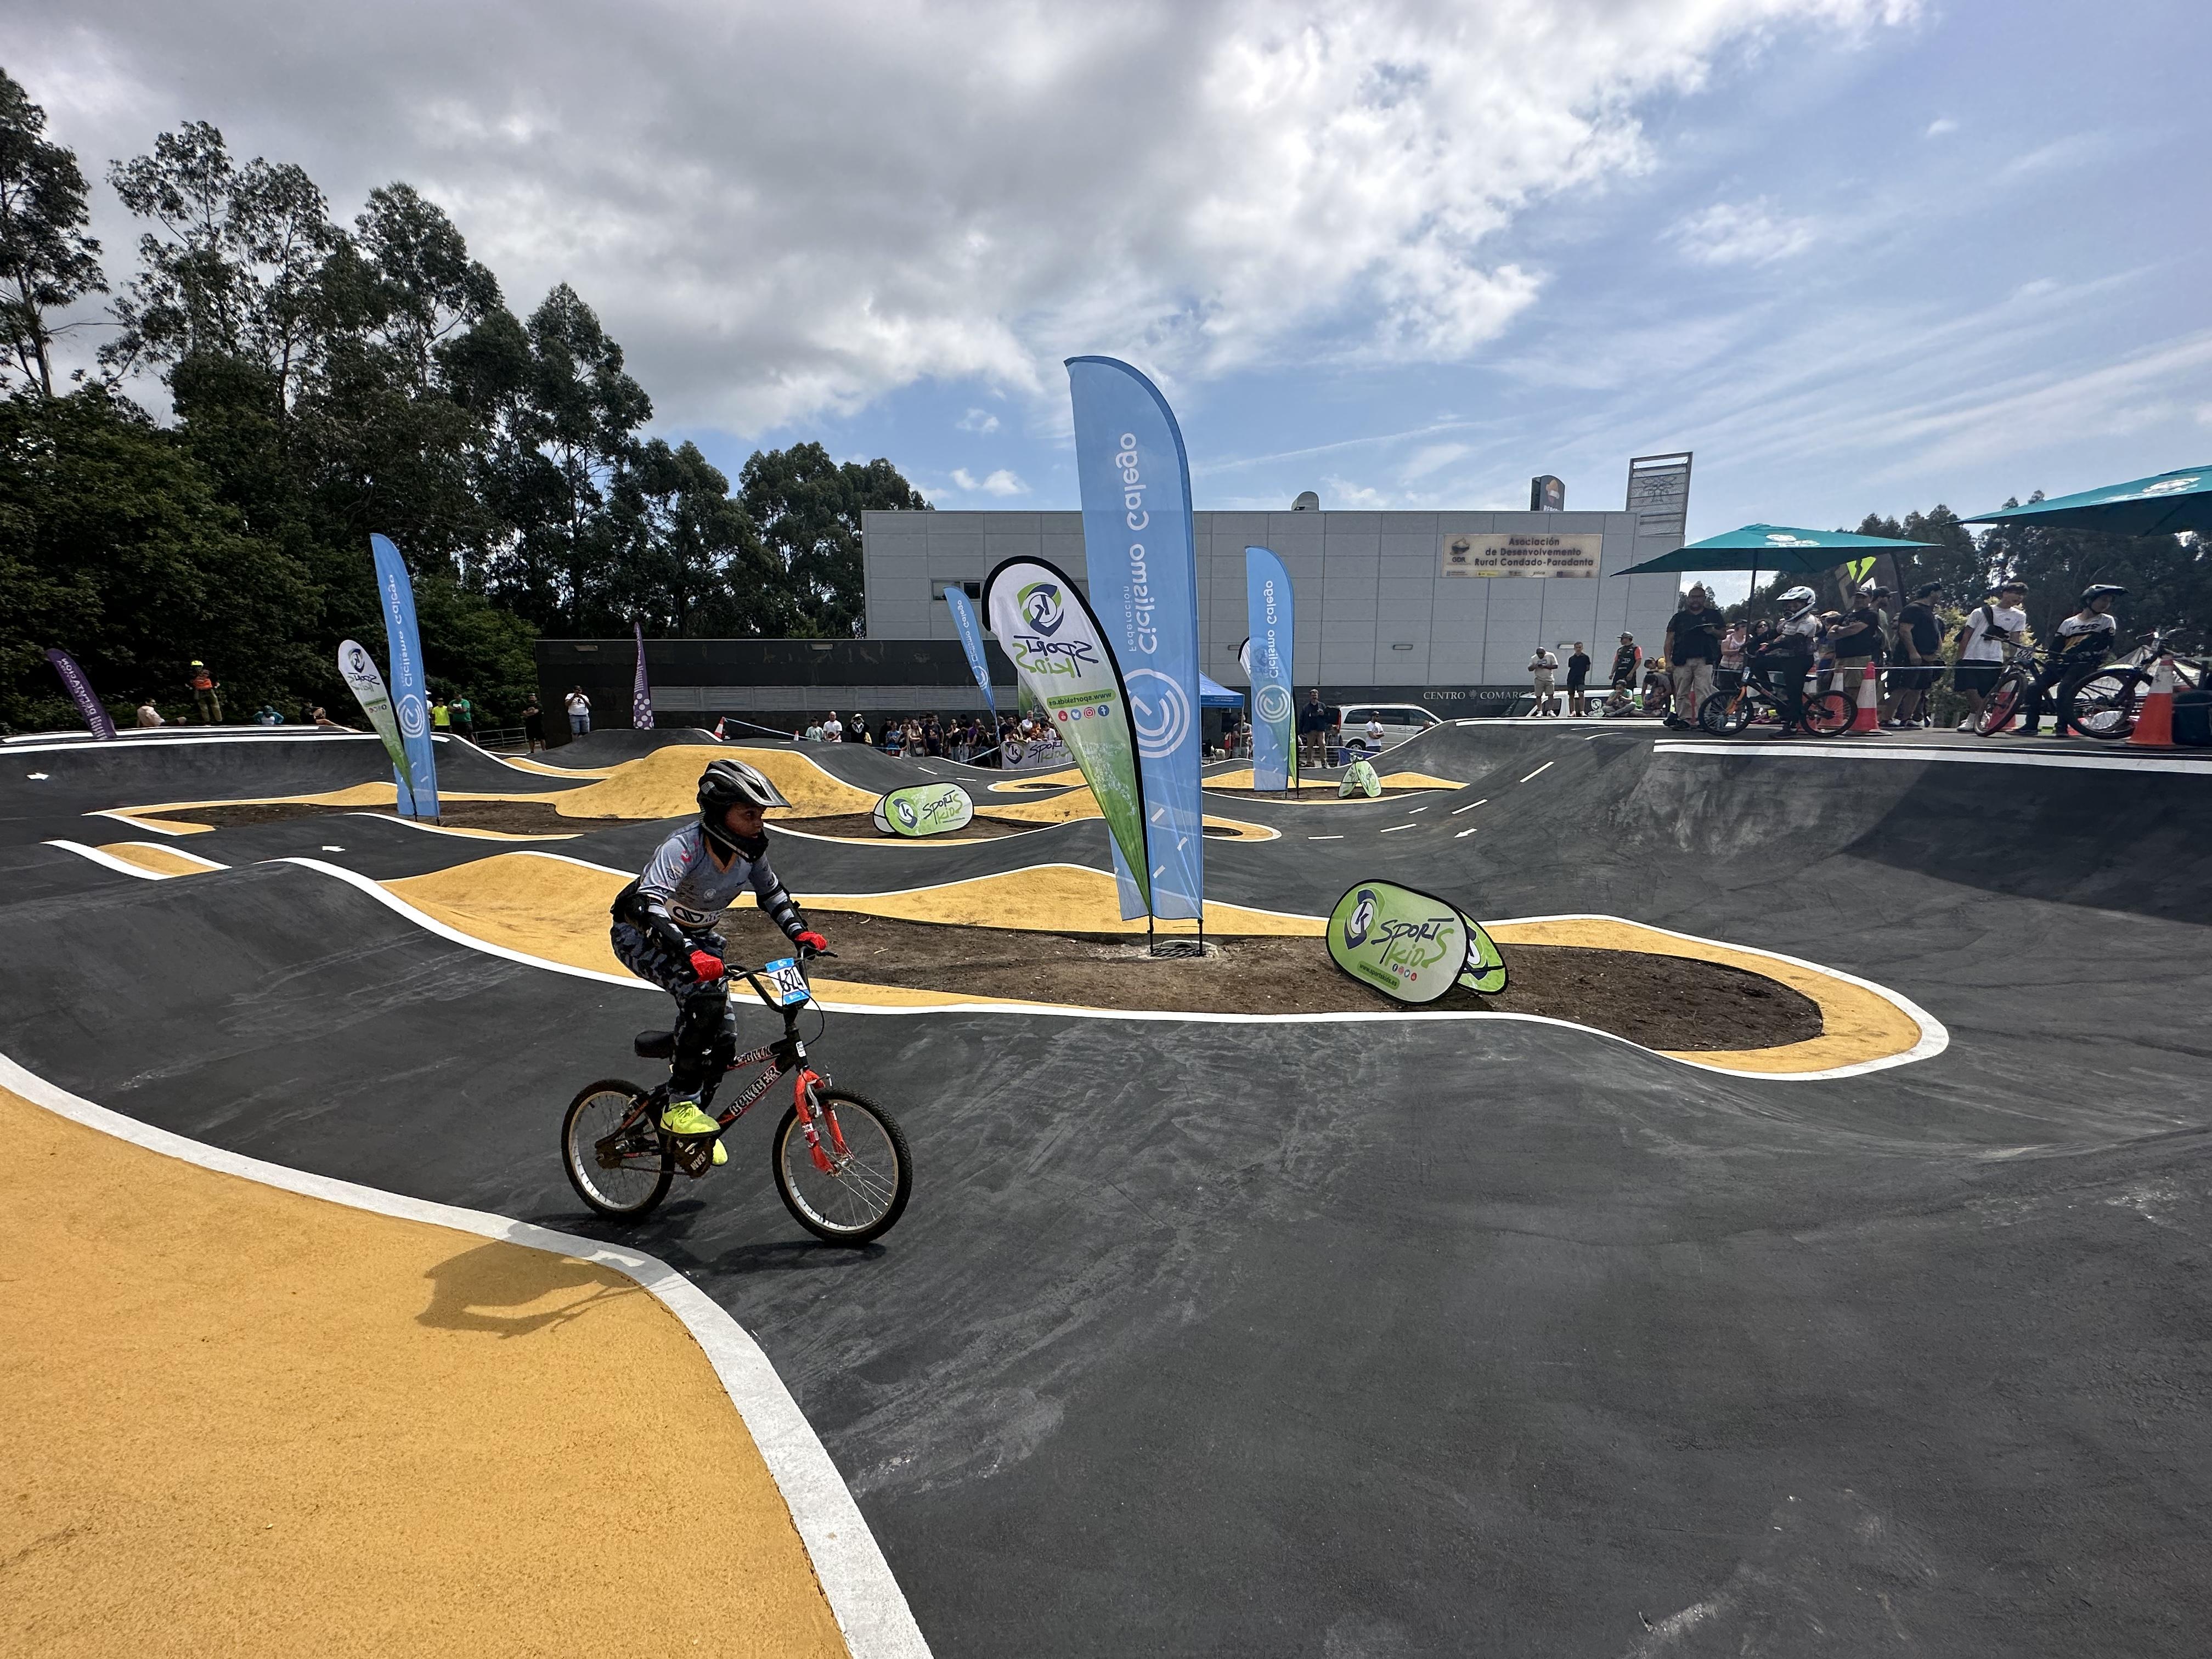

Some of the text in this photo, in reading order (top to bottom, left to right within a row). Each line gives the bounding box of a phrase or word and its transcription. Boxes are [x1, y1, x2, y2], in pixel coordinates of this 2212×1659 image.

[1509, 537, 1559, 546] Asociación
[1486, 548, 1581, 556] de Desenvolvemento
[1475, 558, 1593, 567] Rural Condado-Paradanta
[2016, 648, 2033, 661] 626
[1423, 691, 1466, 700] CENTRO
[1359, 963, 1398, 988] www.sportskids.es
